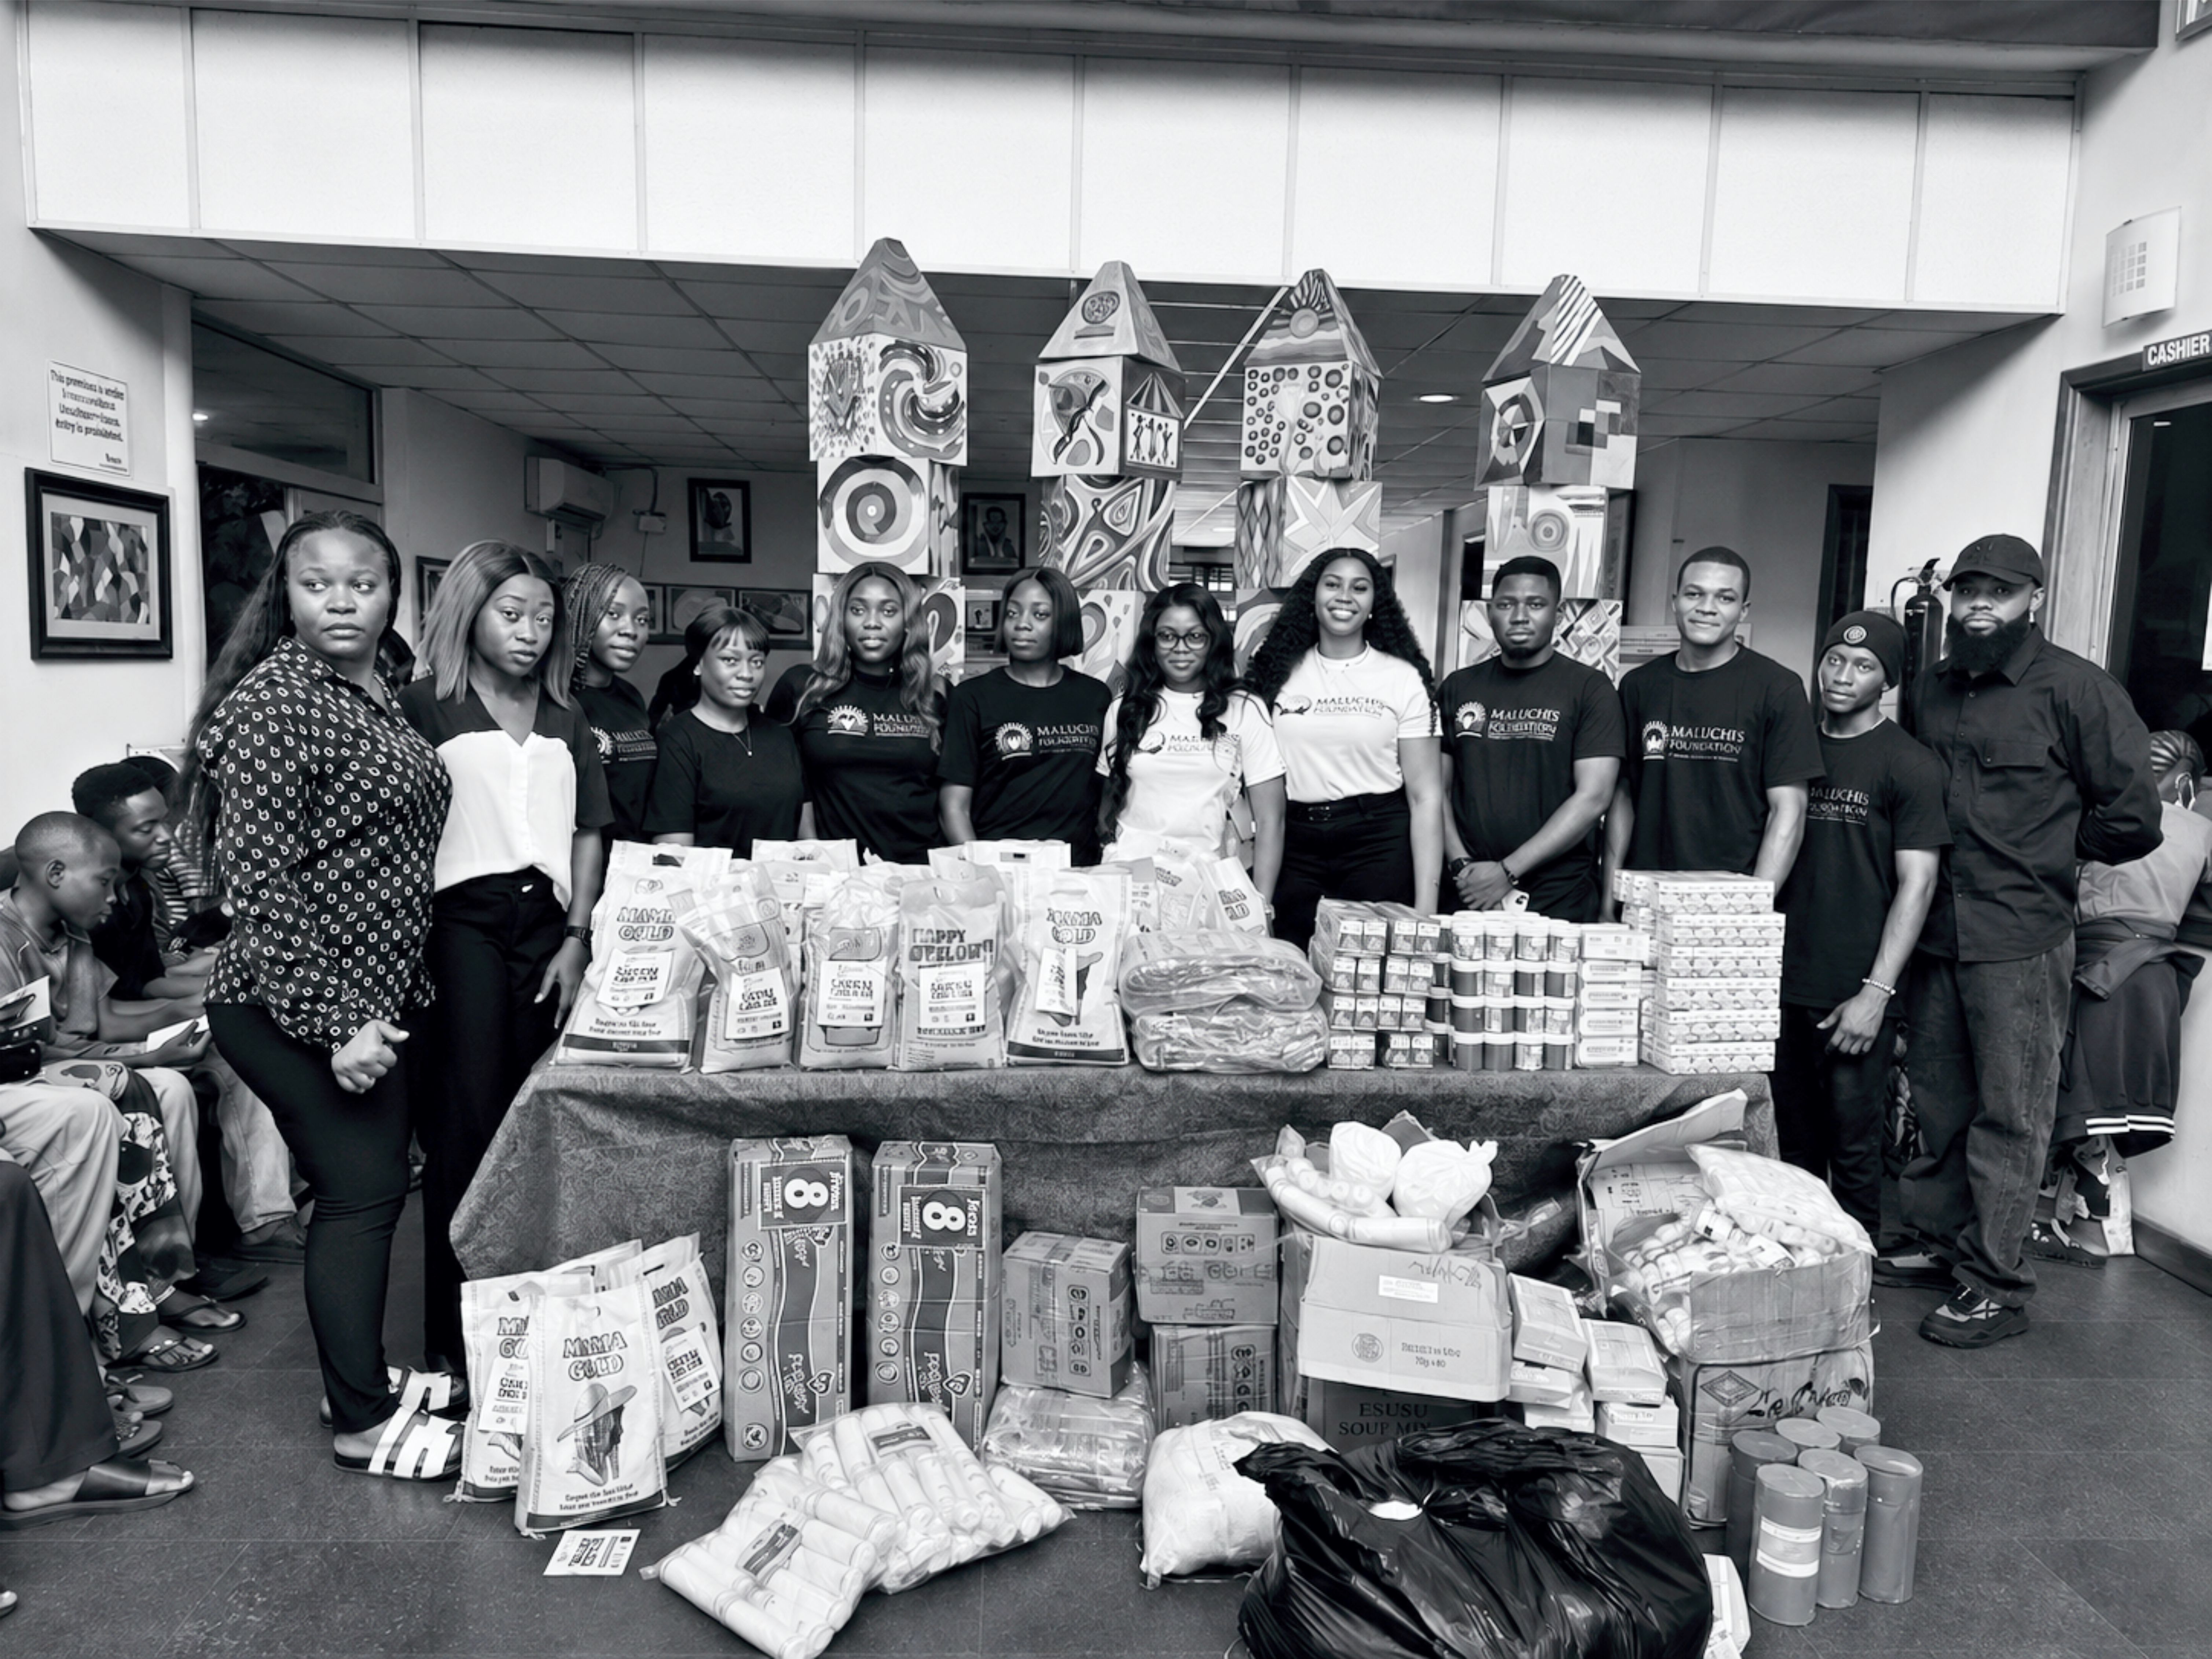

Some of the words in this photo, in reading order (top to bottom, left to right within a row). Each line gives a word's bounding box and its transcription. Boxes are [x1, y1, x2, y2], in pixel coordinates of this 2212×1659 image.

[2147, 334, 2210, 366] CASHIER
[50, 369, 65, 383] This
[1671, 725, 1745, 743] MALUCHIS
[1669, 738, 1742, 754] FOUNDATION
[784, 1178, 829, 1209] 8
[922, 1201, 966, 1231] 8
[1359, 1402, 1428, 1418] ESUSU
[1339, 1421, 1390, 1436] SOUP
